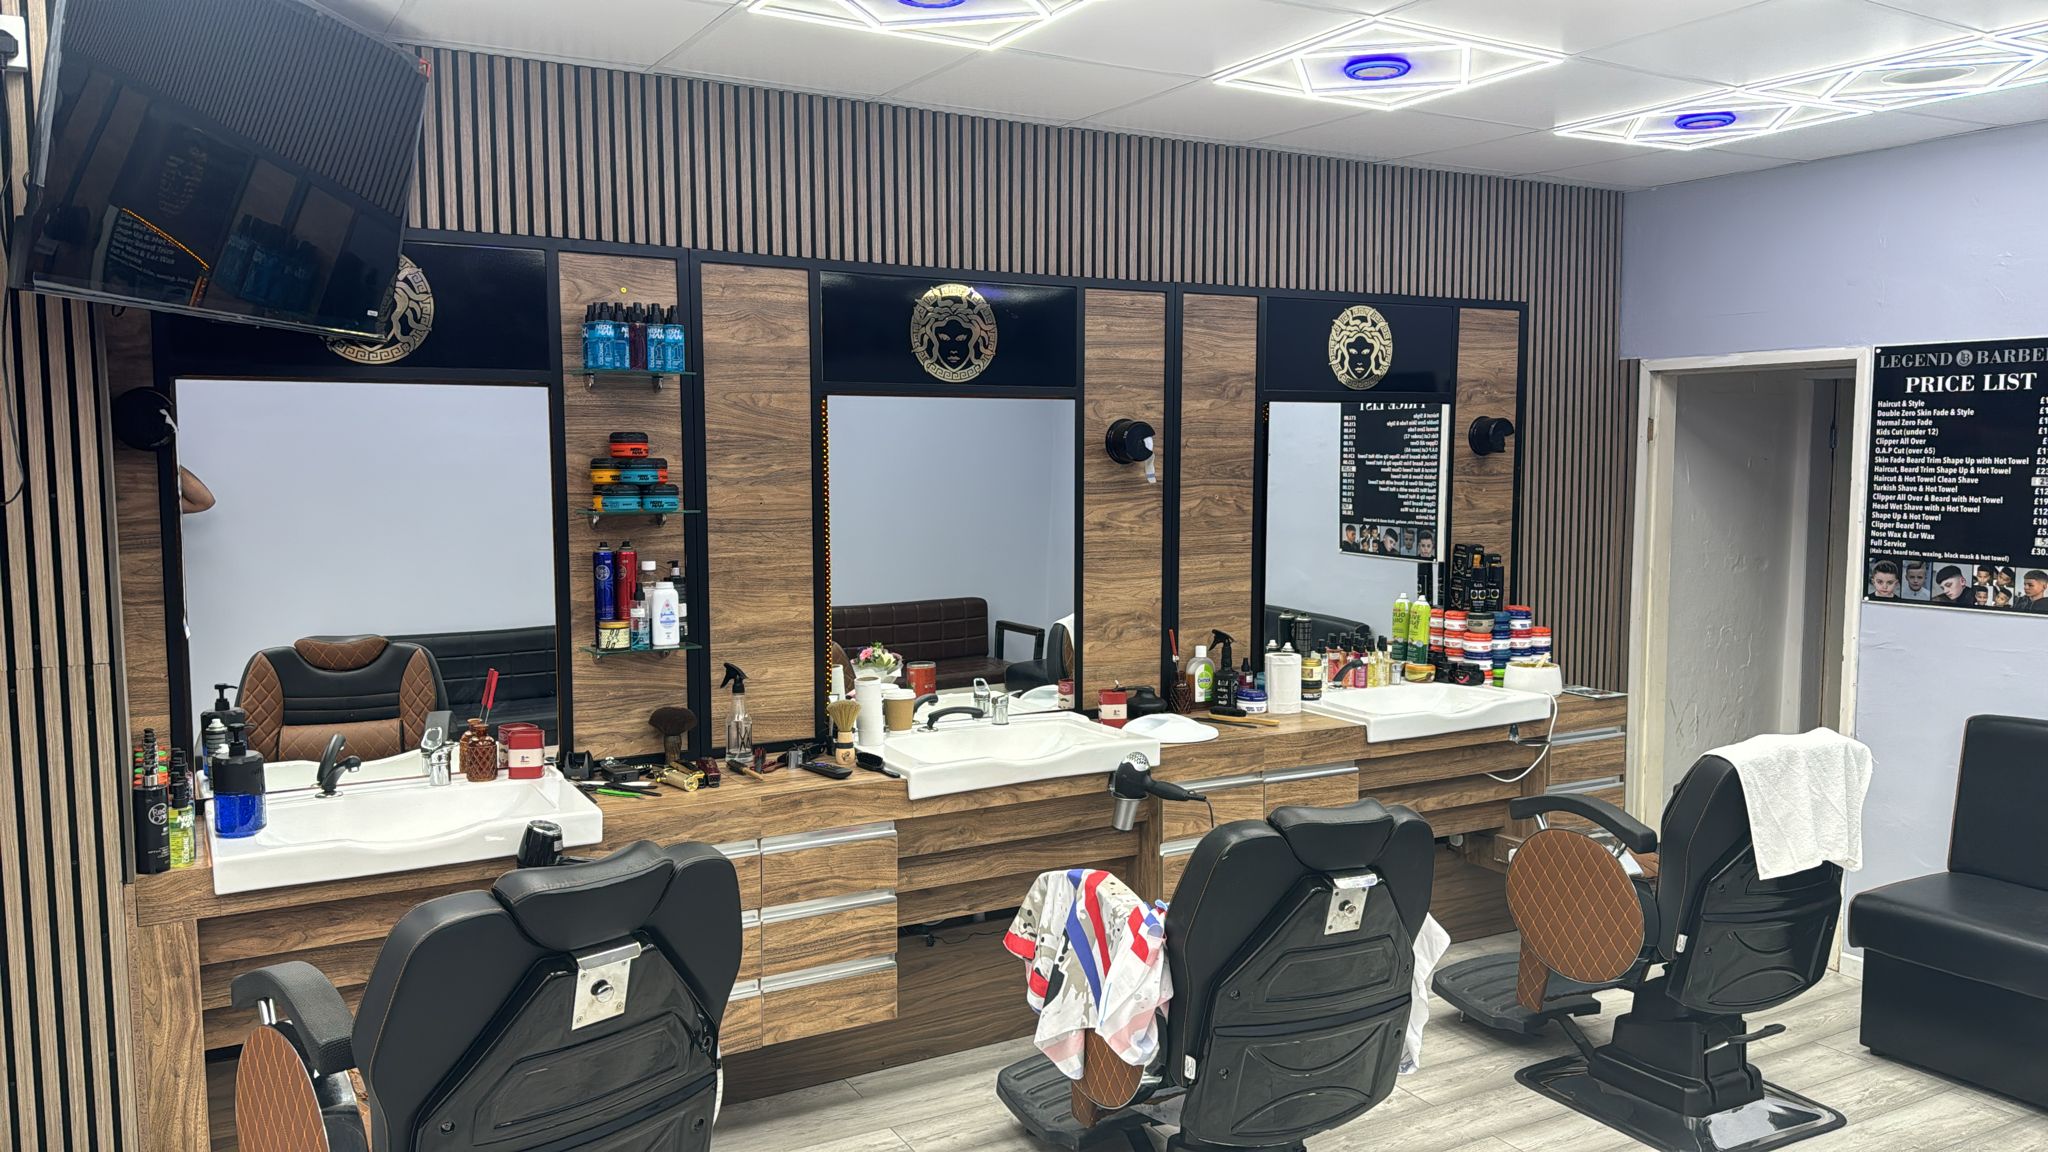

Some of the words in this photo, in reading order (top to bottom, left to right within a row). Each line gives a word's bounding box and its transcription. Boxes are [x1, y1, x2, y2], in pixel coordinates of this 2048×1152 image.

[1880, 352, 1953, 368] LEGEND
[1905, 375, 1975, 393] PRICE
[1983, 372, 2038, 391] LIST
[1908, 400, 1925, 408] Style
[1957, 408, 1974, 417] Style
[1904, 428, 1926, 436] (under
[1928, 428, 1938, 436] 12)
[1876, 438, 1899, 446] Clipper
[1924, 447, 1935, 455] 65)
[1943, 457, 1964, 466] Shape
[1965, 457, 1975, 466] Up
[2008, 457, 2029, 465] Towel
[1937, 466, 1957, 475] Shape
[1959, 467, 1968, 475] Up
[1917, 475, 1936, 483] Towel
[1958, 476, 1979, 484] Shave
[1898, 484, 1917, 492] Shave
[1938, 485, 1958, 493] Towel
[1873, 493, 1896, 502] Clipper
[1952, 495, 1967, 503] with
[1983, 496, 2003, 504] Towel
[1872, 502, 1889, 510] Head
[1904, 503, 1923, 511] Shave
[1960, 505, 1980, 513] Towel
[1872, 512, 1891, 521] Shape
[1892, 513, 1901, 521] Up
[1871, 521, 1894, 530] Clipper
[1871, 530, 1886, 538] Nose
